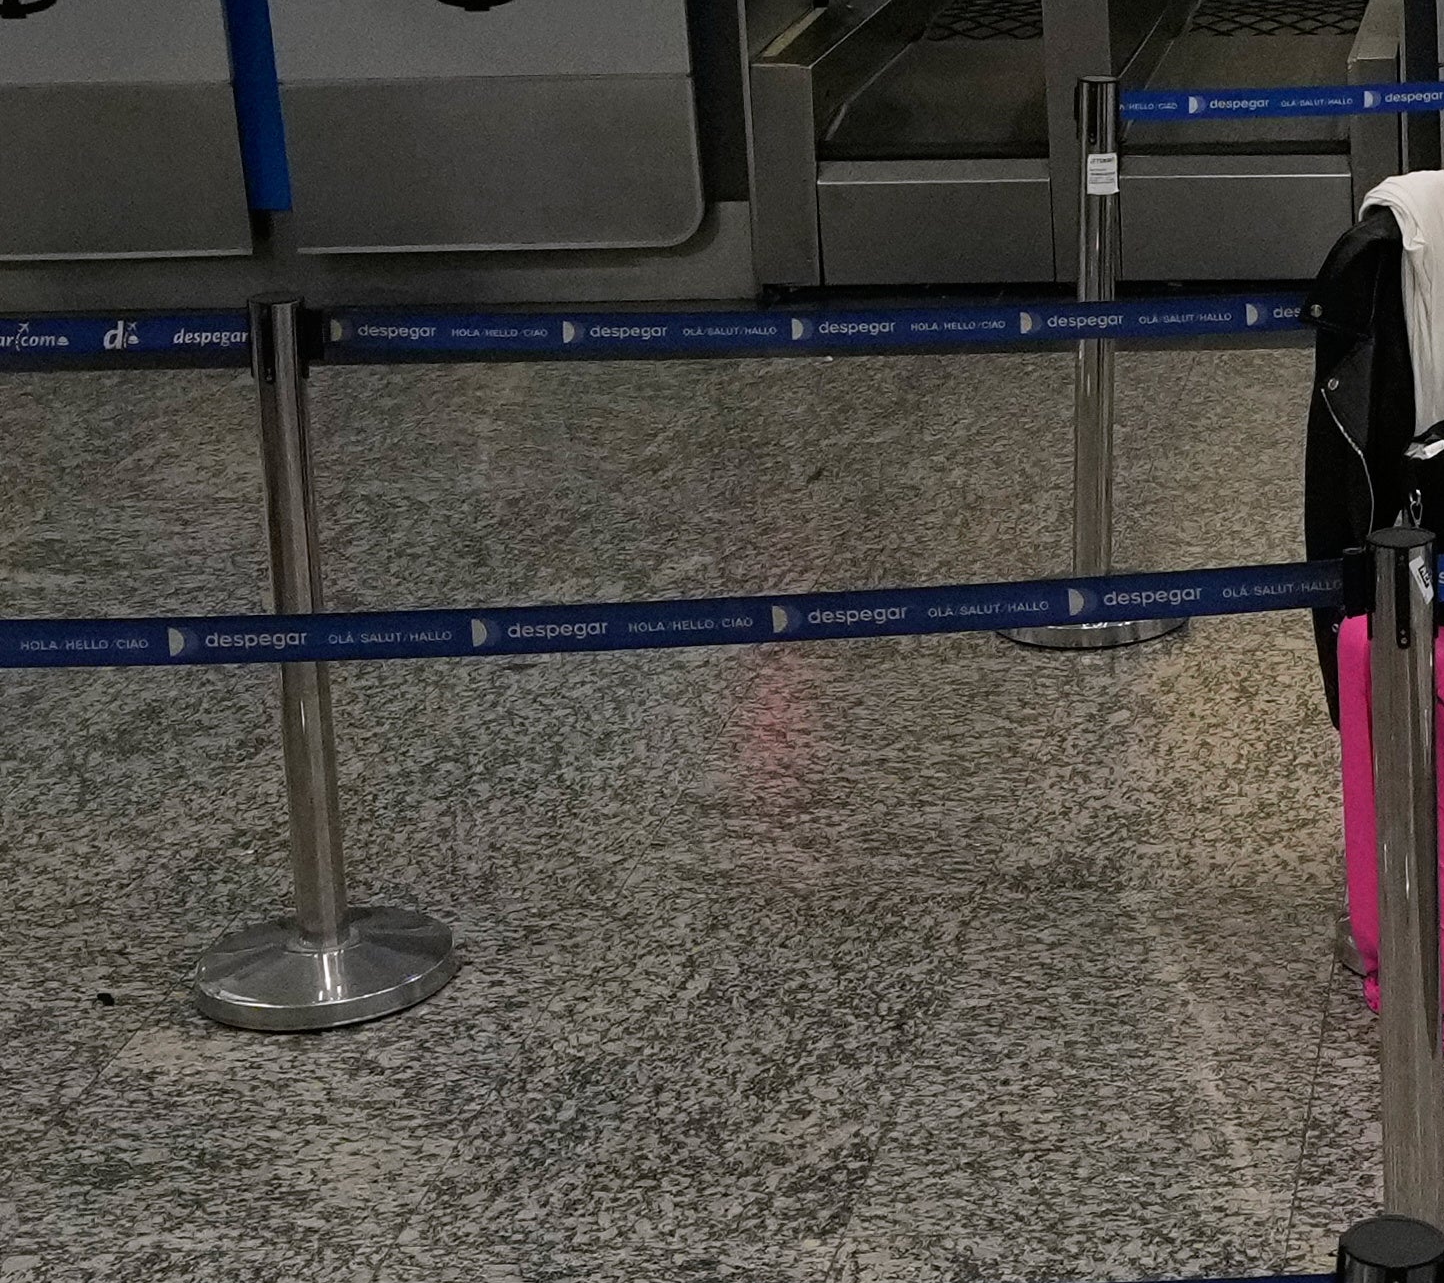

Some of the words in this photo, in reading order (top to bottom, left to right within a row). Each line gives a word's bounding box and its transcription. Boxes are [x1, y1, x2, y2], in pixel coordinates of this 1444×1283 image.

[1210, 99, 1268, 110] despegar
[1386, 92, 1442, 103] despegar
[173, 329, 248, 346] despegar
[358, 325, 435, 340] despegar
[590, 326, 667, 340] despegar
[819, 321, 895, 336] despegar
[1048, 315, 1123, 329] despegar
[206, 632, 307, 650] despegar
[508, 622, 607, 640] despegar
[808, 607, 907, 626] despegar
[1104, 588, 1202, 607] despegar
